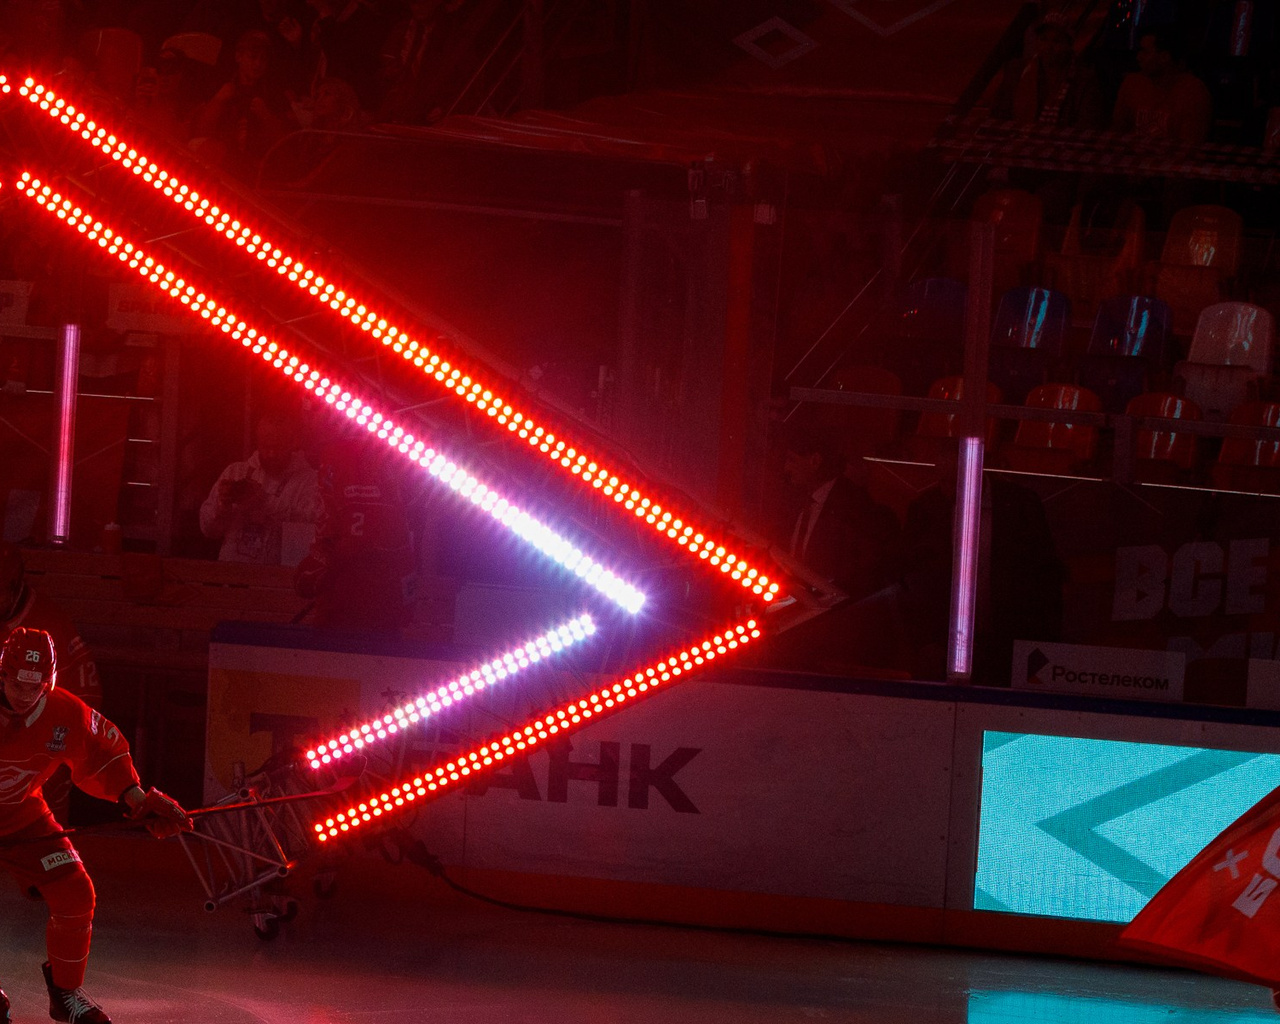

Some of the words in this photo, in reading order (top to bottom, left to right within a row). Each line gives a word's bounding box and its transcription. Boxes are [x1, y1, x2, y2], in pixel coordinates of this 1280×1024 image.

[1111, 537, 1270, 622] ВСЕ
[25, 650, 40, 663] 26
[78, 660, 99, 688] 12
[1052, 665, 1170, 690] Ростелеком
